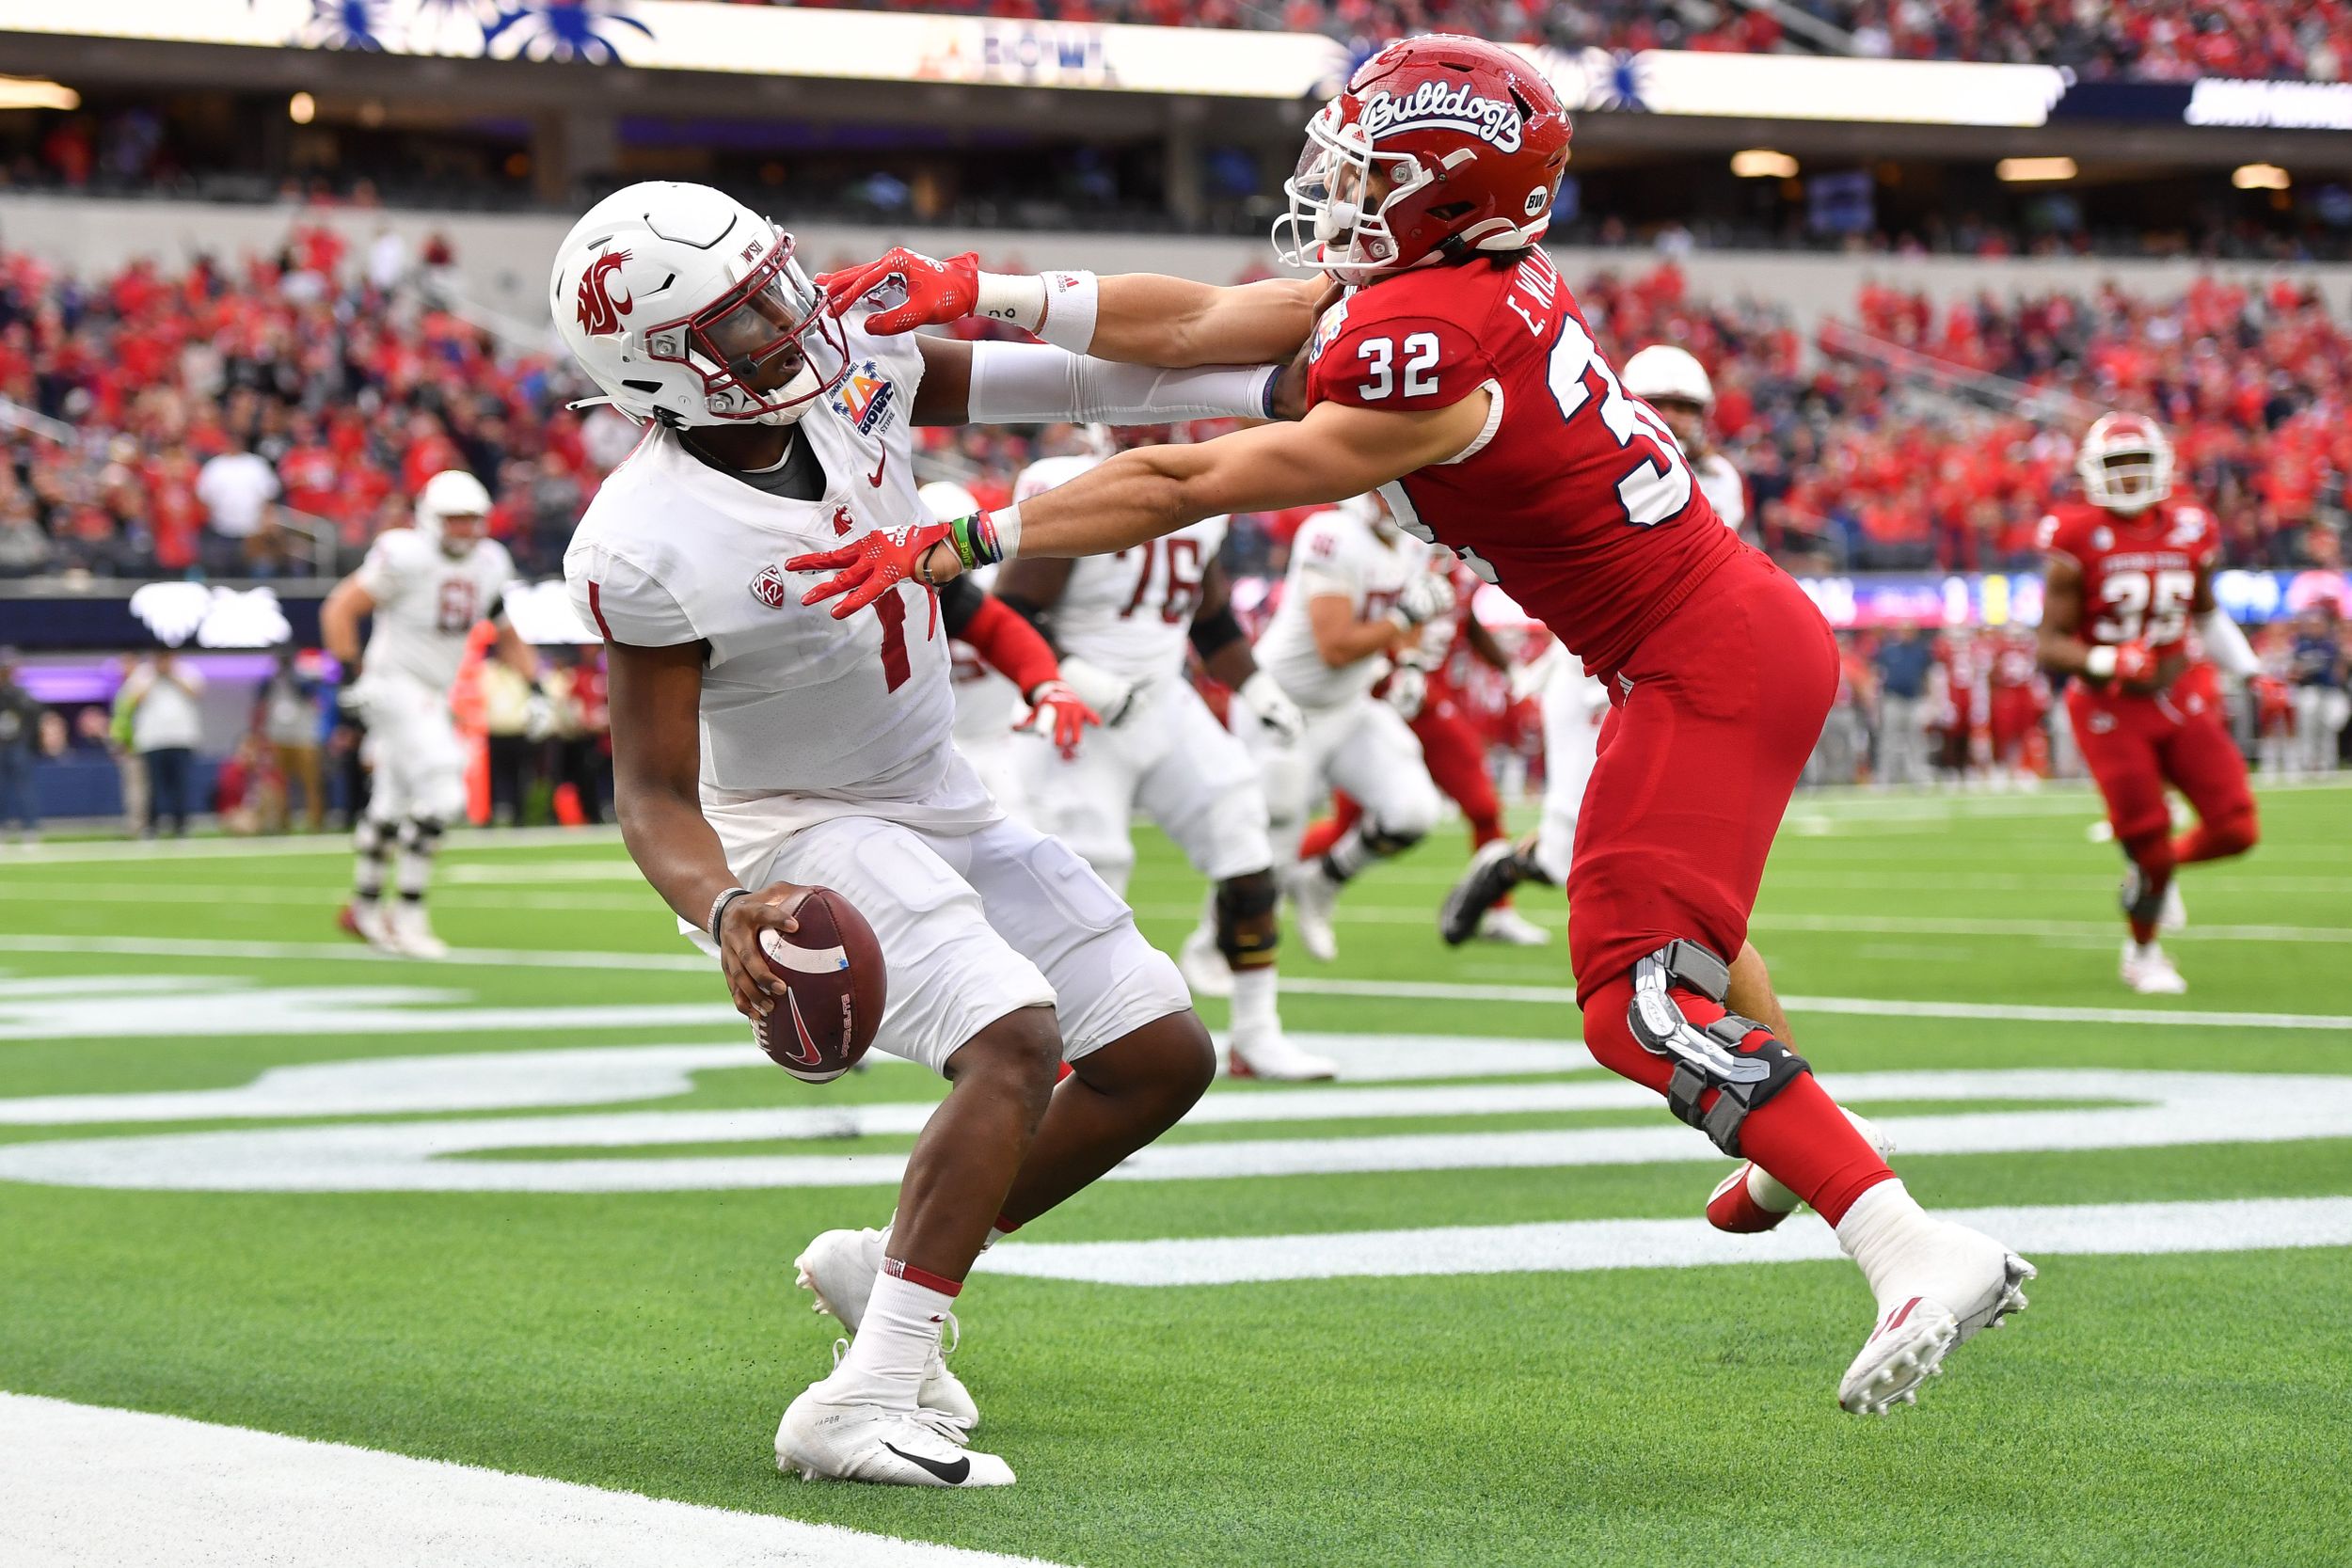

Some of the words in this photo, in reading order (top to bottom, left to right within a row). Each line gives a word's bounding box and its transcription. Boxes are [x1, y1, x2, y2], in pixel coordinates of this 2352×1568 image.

[1362, 81, 1523, 153] Bulldogs
[1526, 193, 1547, 209] BW
[740, 239, 764, 263] WSU
[1515, 242, 1558, 309] WILLI
[828, 380, 843, 399] JIMMY
[842, 362, 860, 385] KIMMEL
[1358, 332, 1438, 401] 32
[842, 375, 885, 426] LA
[860, 390, 895, 436] BOWL
[880, 411, 896, 435] STIFEL
[752, 566, 783, 601] PAC
[765, 583, 784, 606] 12
[1115, 539, 1203, 624] 76
[2091, 569, 2197, 646] 35
[840, 993, 852, 1028] ELITE
